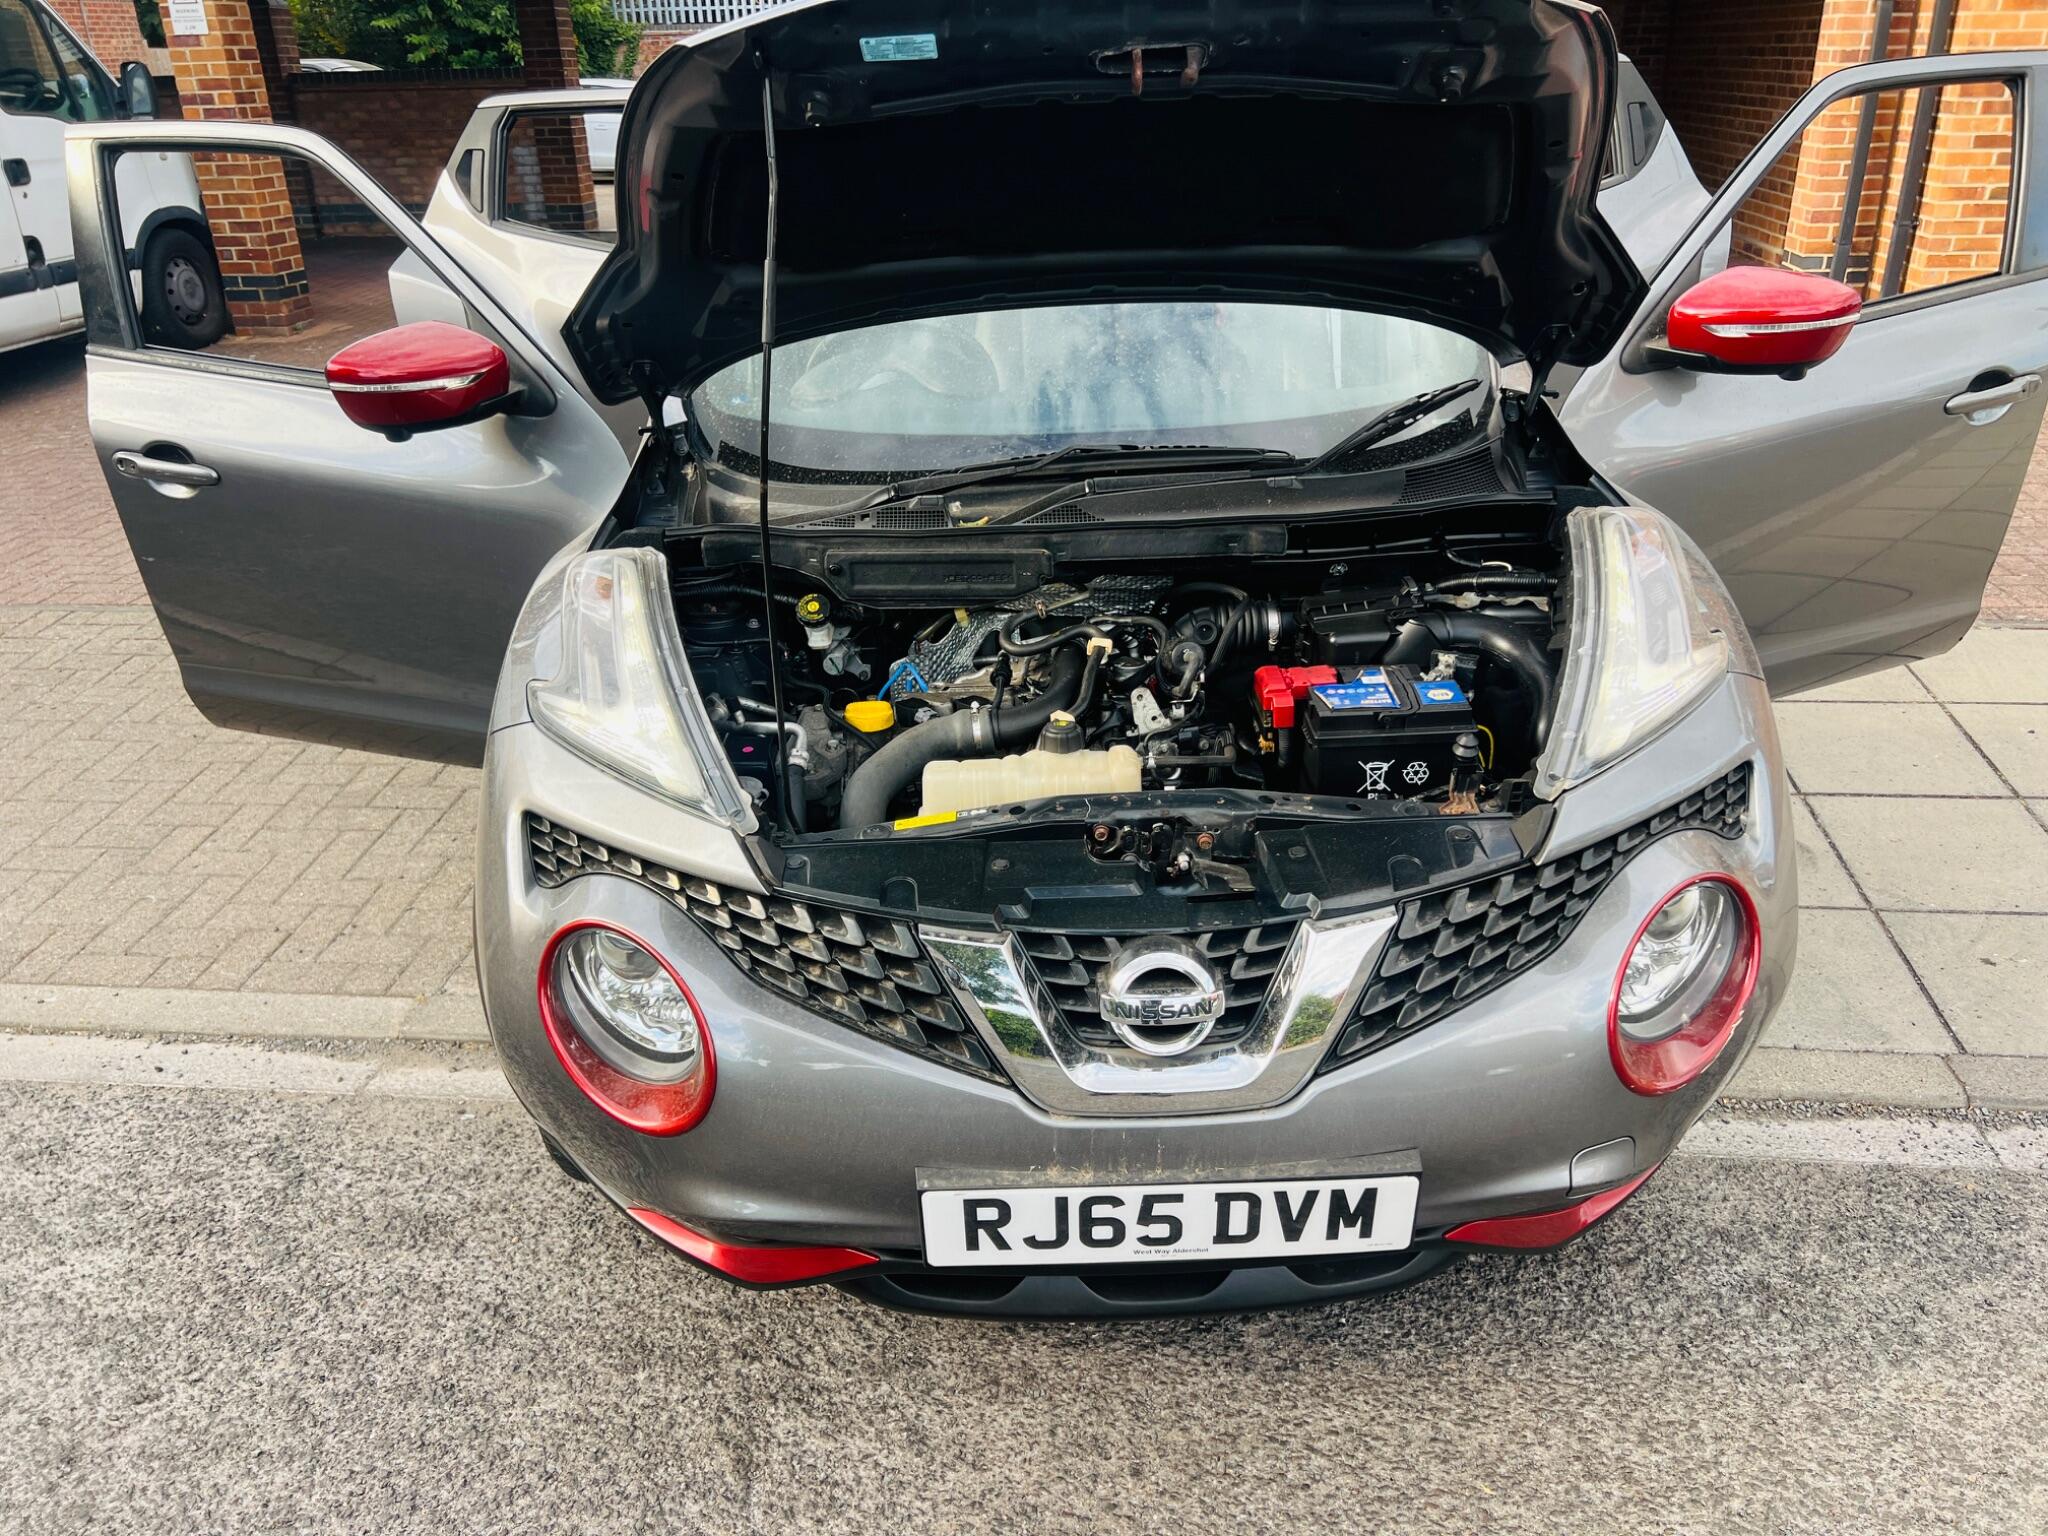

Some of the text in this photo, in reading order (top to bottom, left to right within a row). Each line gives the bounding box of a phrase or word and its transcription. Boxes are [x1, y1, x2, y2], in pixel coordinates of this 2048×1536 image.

[1113, 997, 1214, 1020] NISSAN
[962, 1187, 1379, 1252] RJ65 DVM
